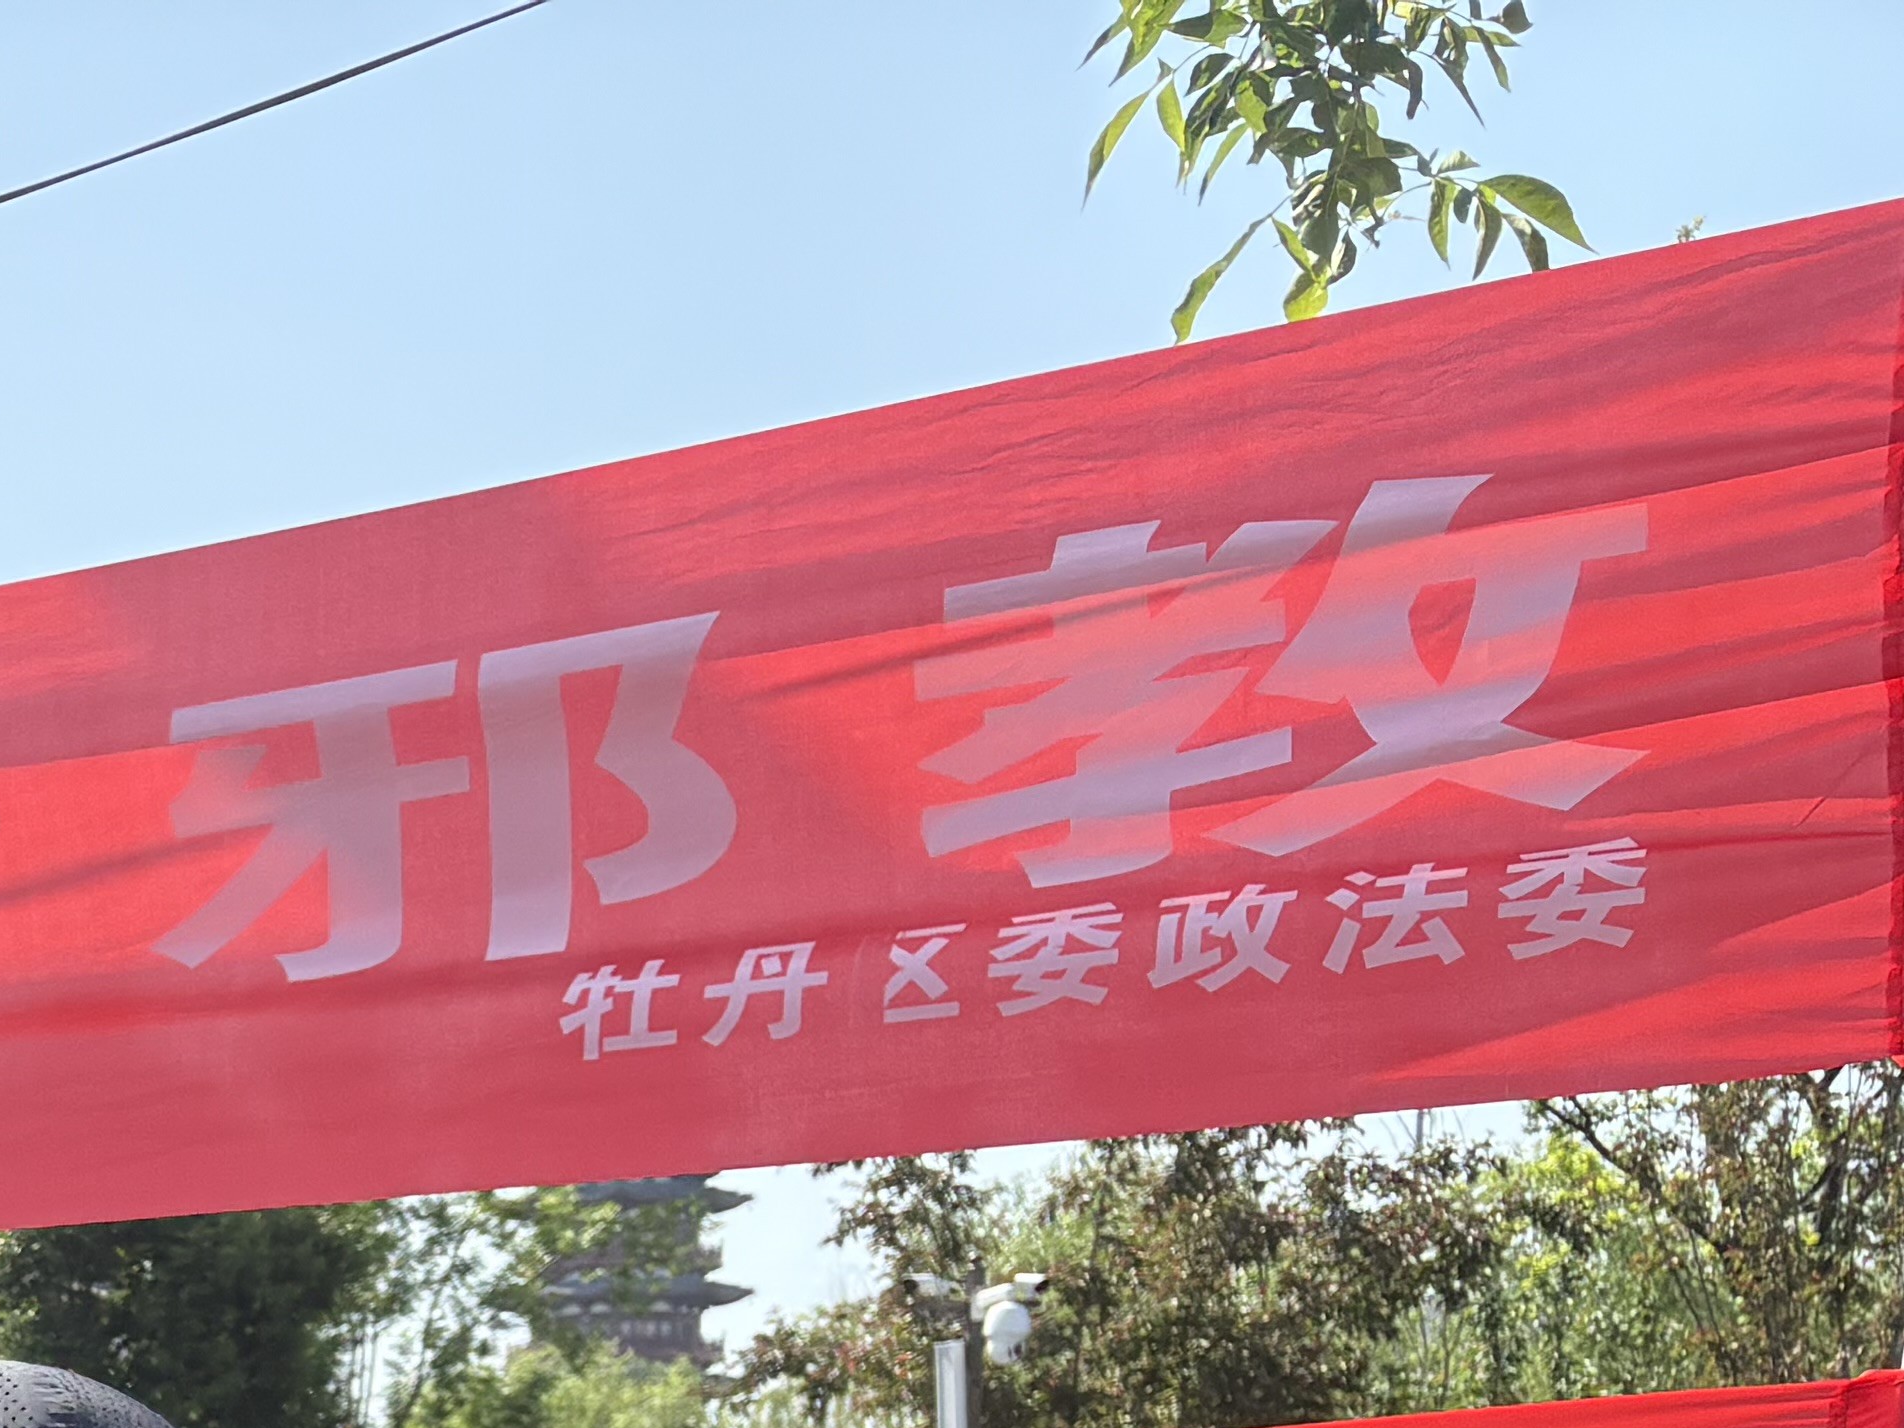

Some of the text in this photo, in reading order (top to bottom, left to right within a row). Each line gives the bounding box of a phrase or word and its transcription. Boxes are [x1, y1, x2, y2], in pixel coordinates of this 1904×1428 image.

[560, 837, 1649, 1061] 牡丹区委政法委
